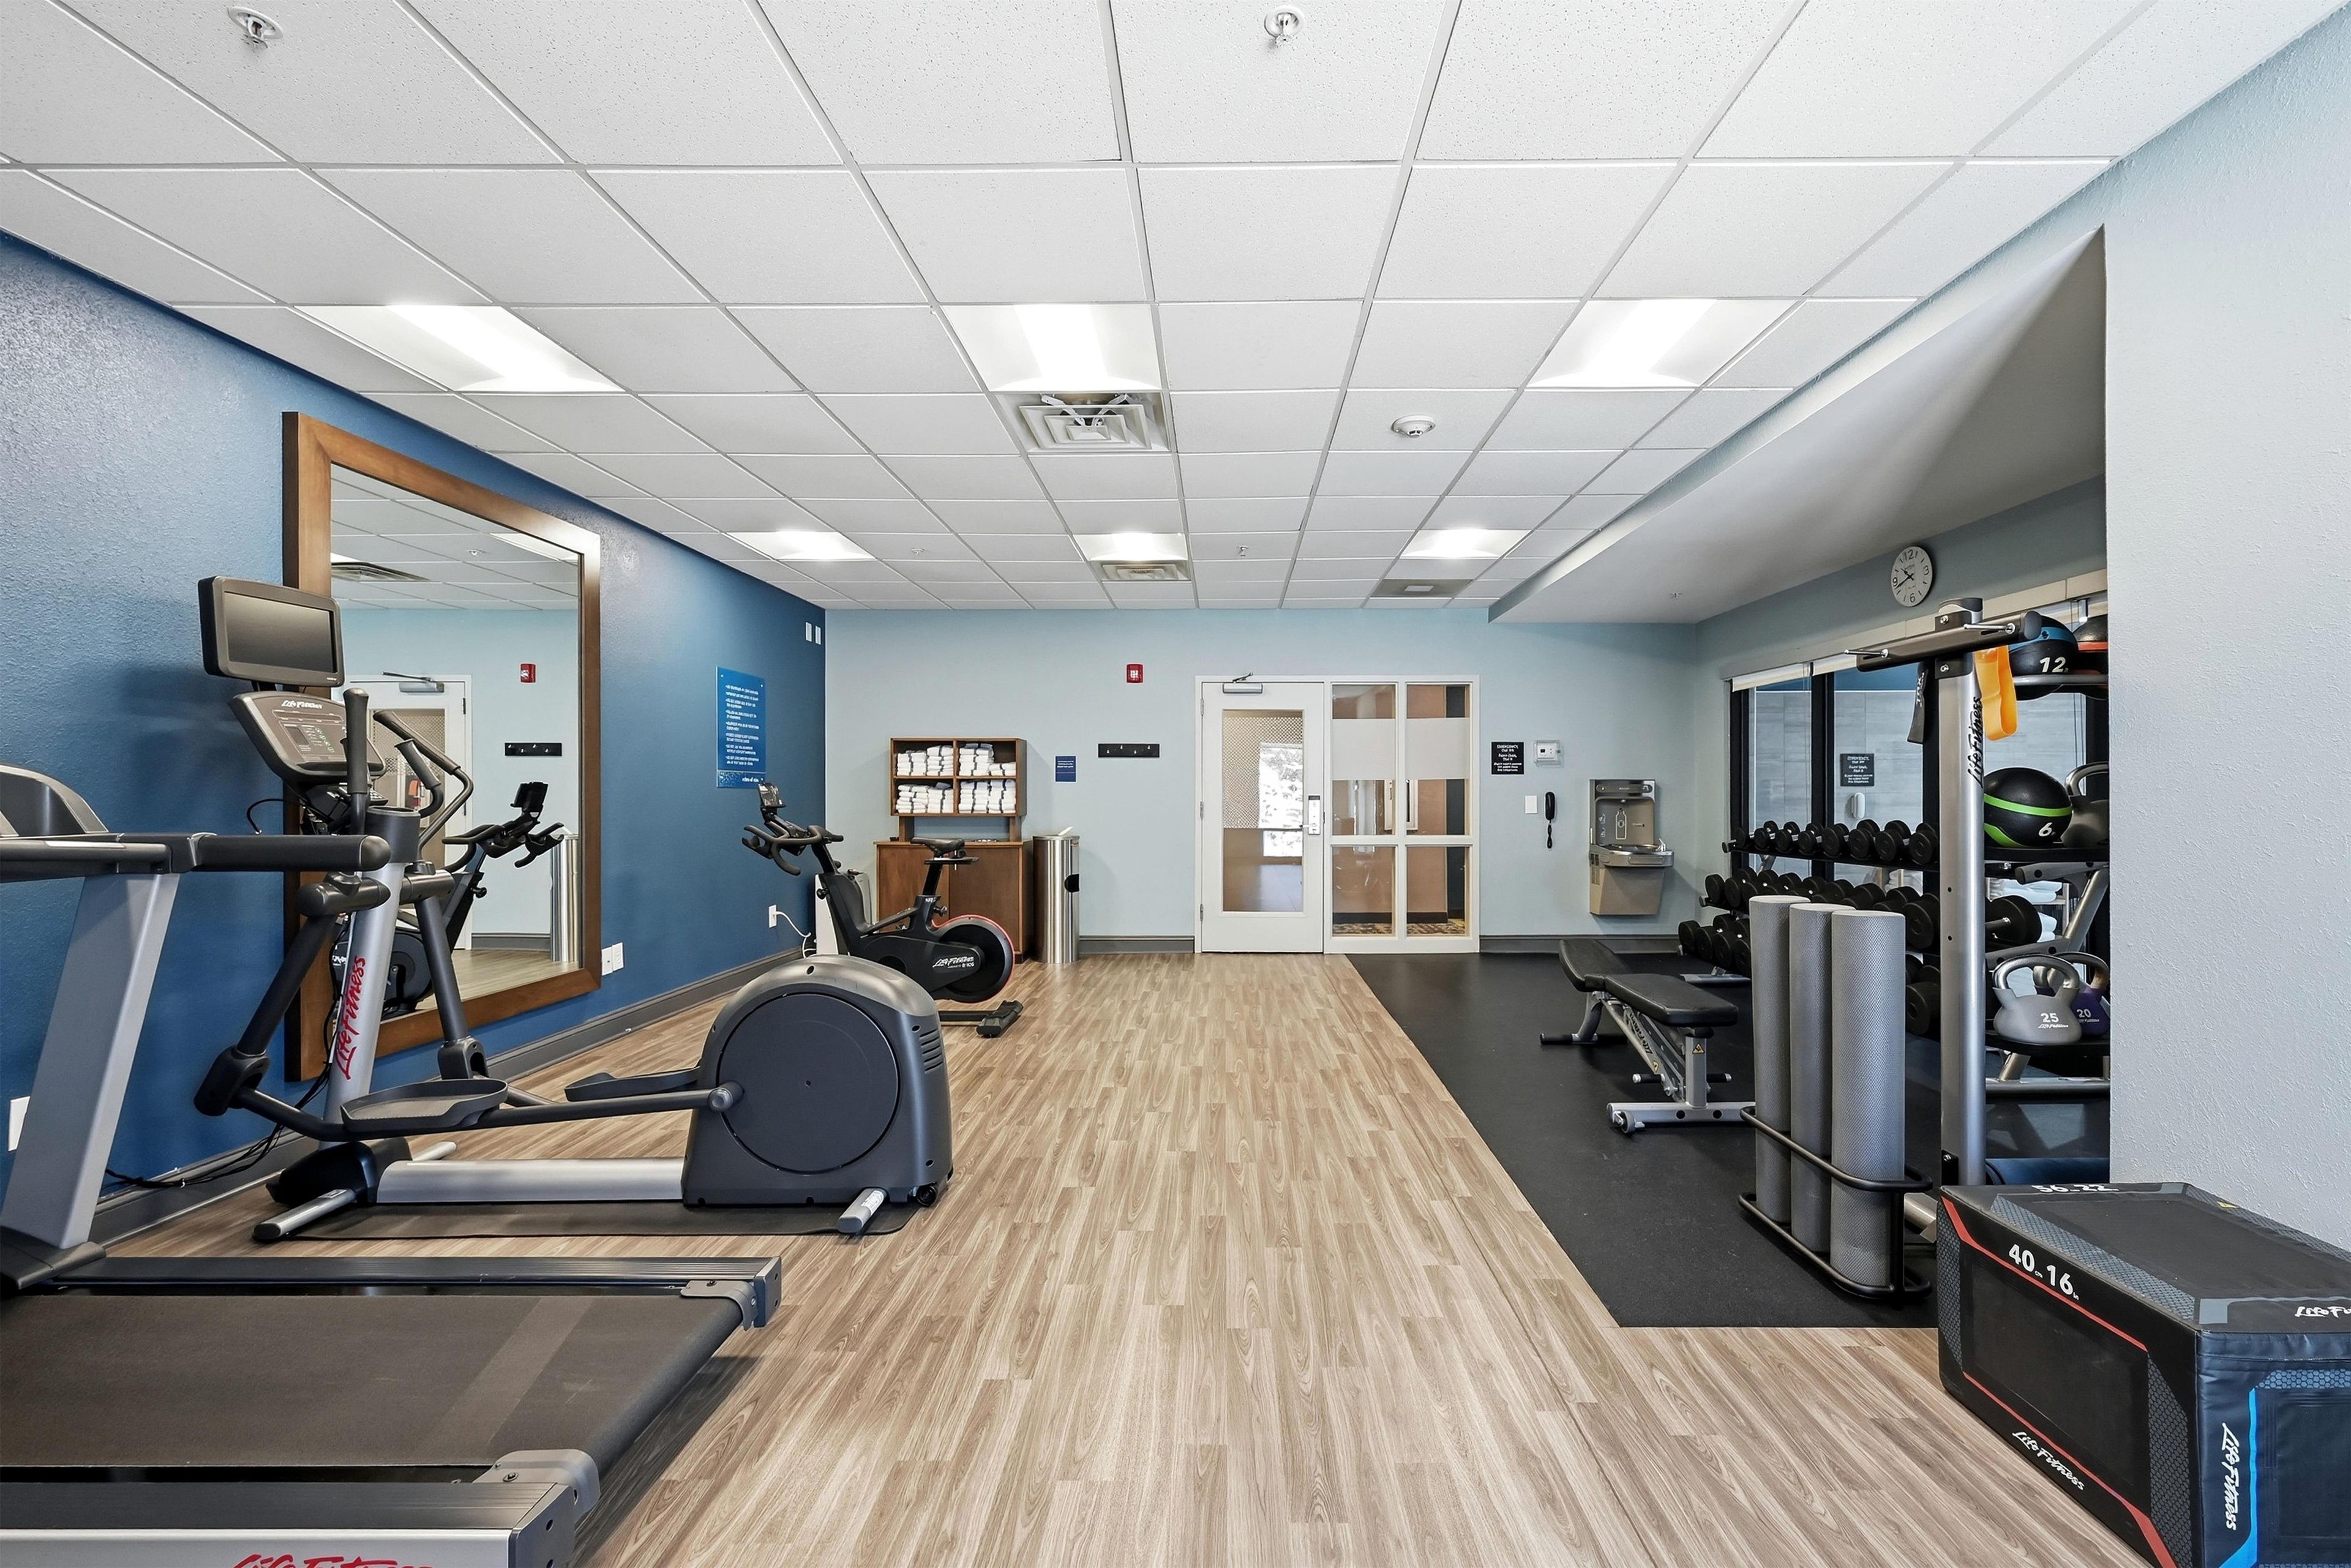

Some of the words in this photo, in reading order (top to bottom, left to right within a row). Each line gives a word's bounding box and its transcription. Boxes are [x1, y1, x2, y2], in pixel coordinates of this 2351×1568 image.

[1923, 565, 1930, 576] 3
[1892, 577, 1898, 587] 9
[1910, 593, 1916, 603] 6
[2039, 656, 2066, 673] 12
[2038, 822, 2053, 837] 6
[2040, 1012, 2060, 1022] 25
[2076, 1008, 2091, 1018] 20
[2009, 1244, 2035, 1272] 40
[2046, 1264, 2074, 1295] 16
